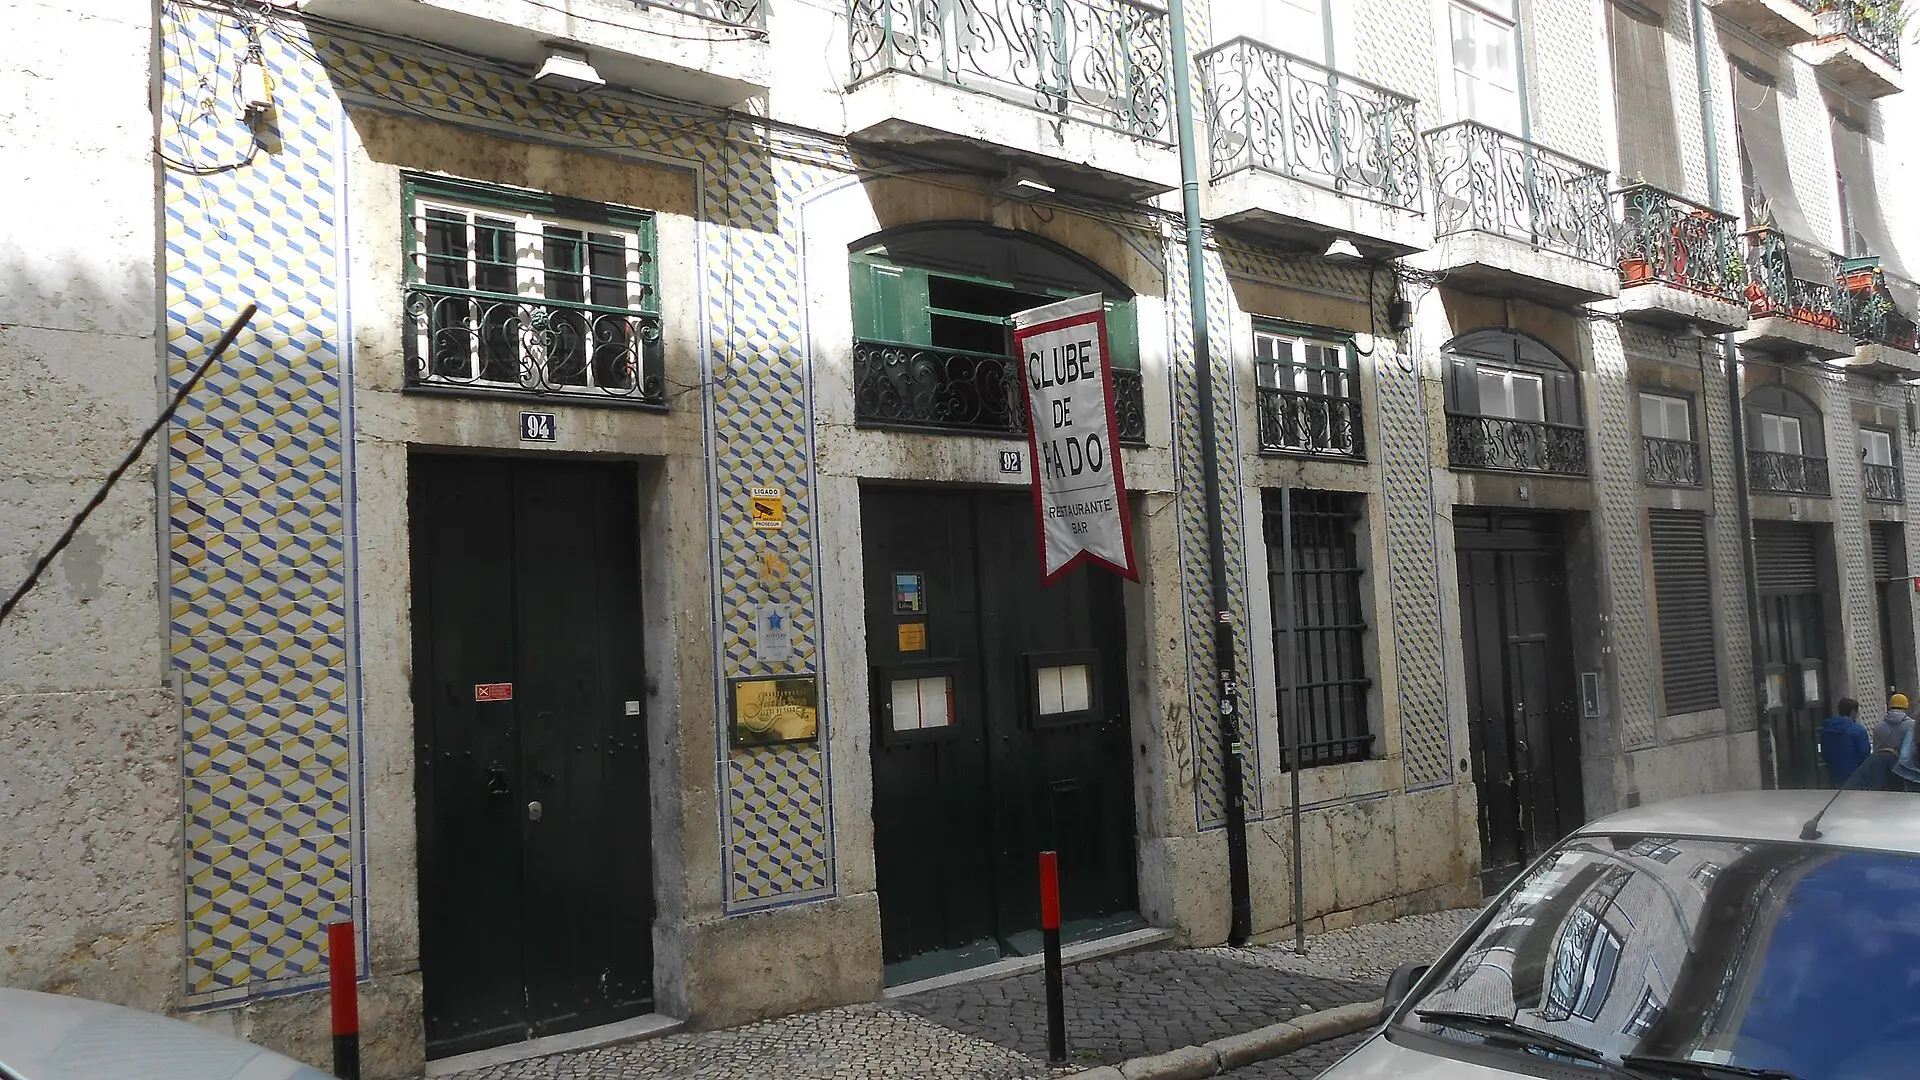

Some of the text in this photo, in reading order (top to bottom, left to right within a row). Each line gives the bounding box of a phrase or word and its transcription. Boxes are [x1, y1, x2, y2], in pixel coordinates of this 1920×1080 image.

[1029, 339, 1095, 391] CLUBE
[1052, 396, 1073, 429] DE
[527, 415, 550, 439] 94
[1004, 452, 1018, 470] 92
[1042, 432, 1103, 480] FADO
[1049, 499, 1112, 518] RESTAURANTE
[1071, 521, 1088, 534] BAR
